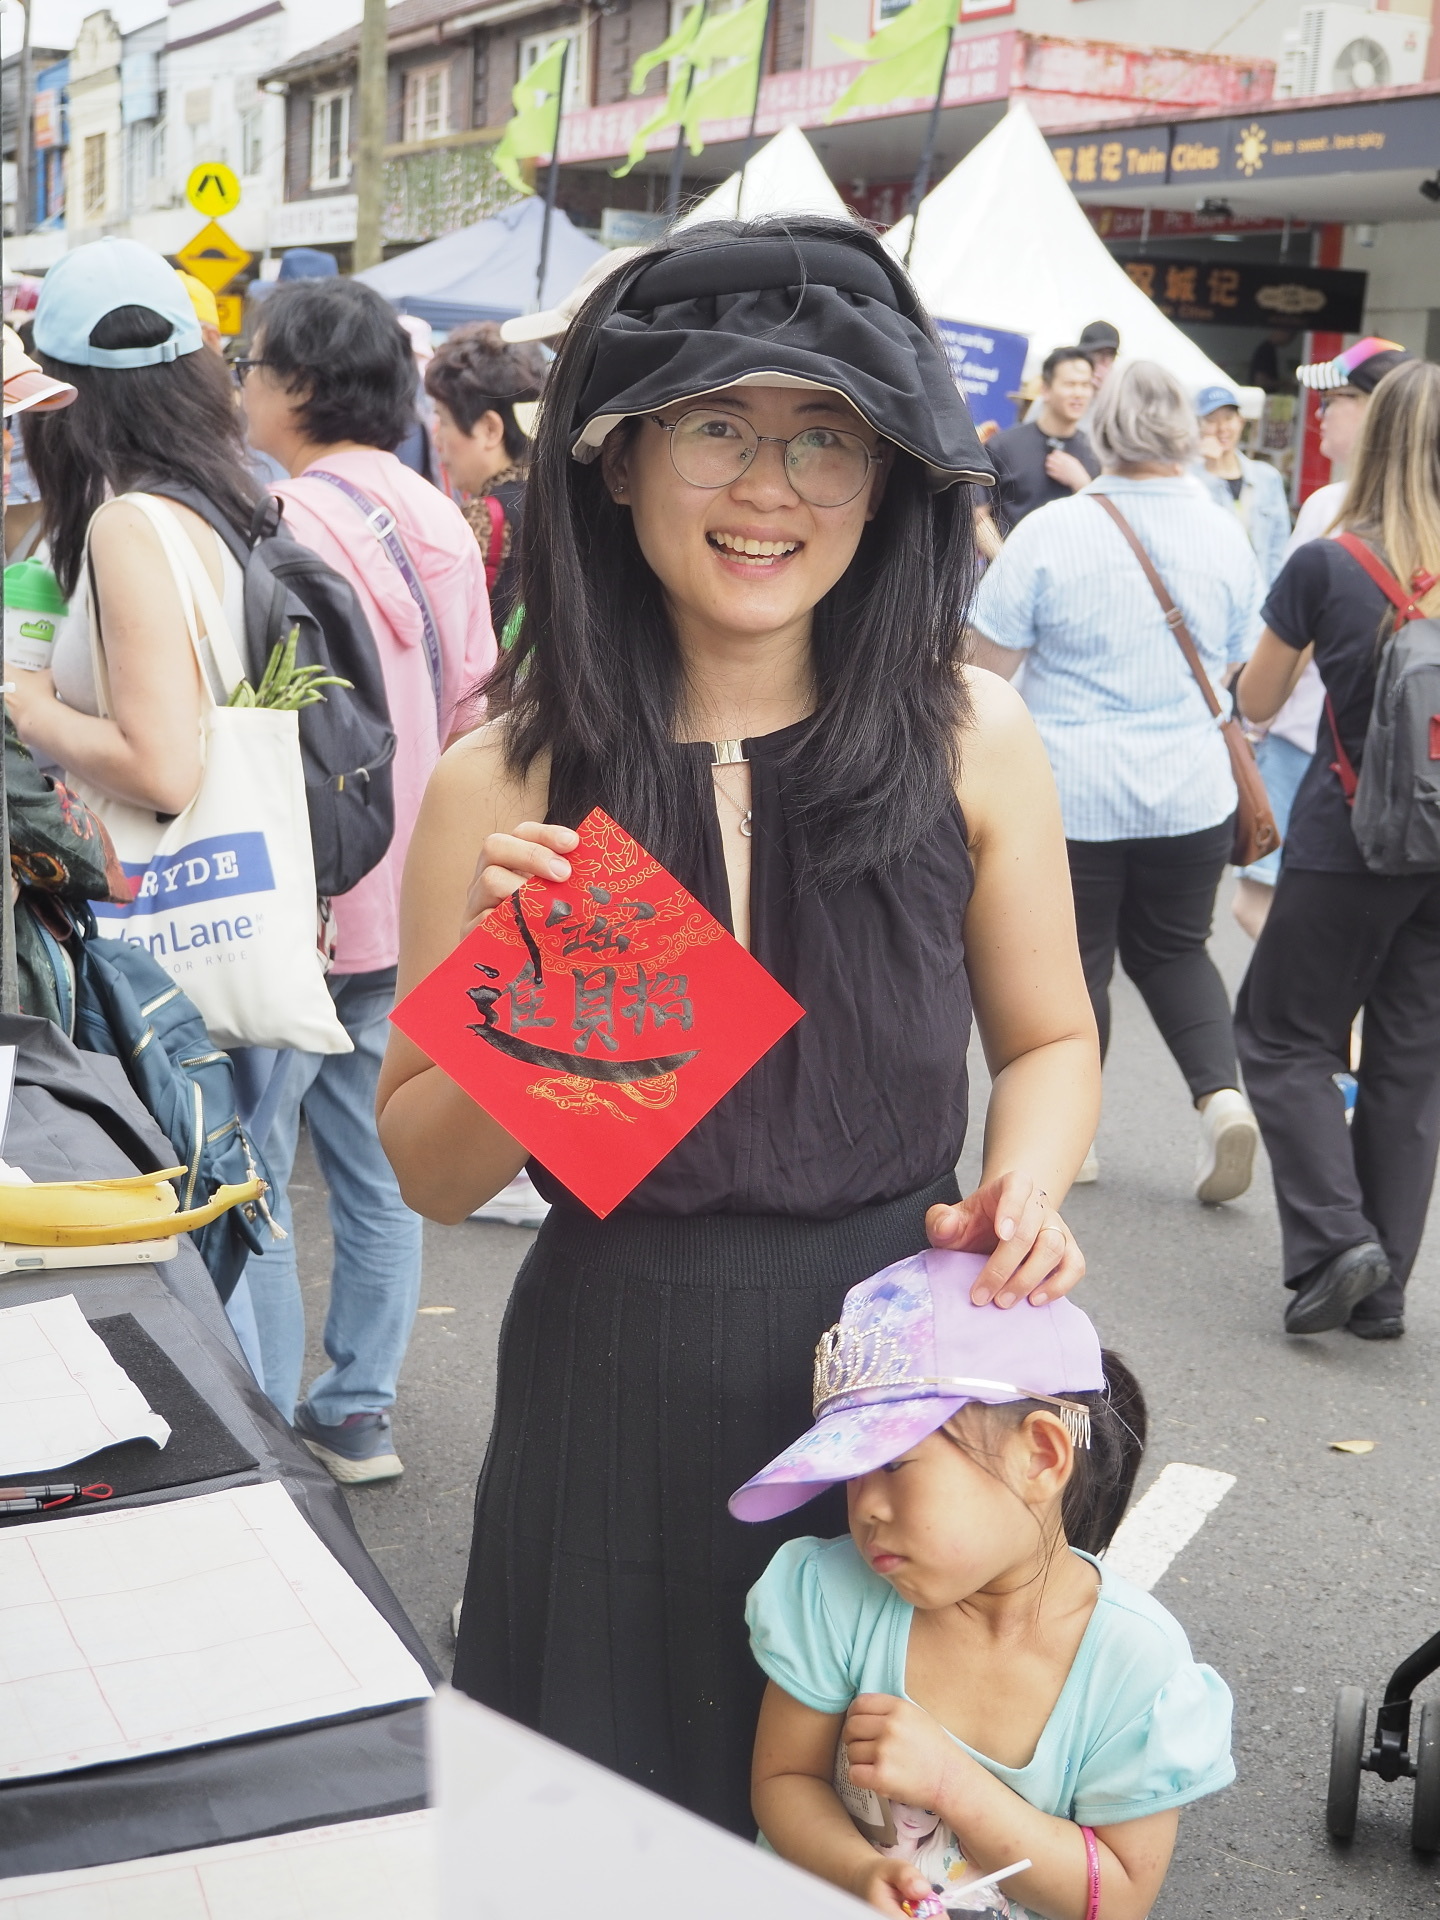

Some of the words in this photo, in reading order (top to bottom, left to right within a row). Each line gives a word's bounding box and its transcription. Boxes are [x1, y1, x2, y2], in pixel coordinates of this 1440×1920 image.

[1127, 147, 1166, 175] Twin
[1170, 142, 1220, 172] Cities
[138, 850, 239, 898] RYDE
[206, 951, 248, 966] RYDE
